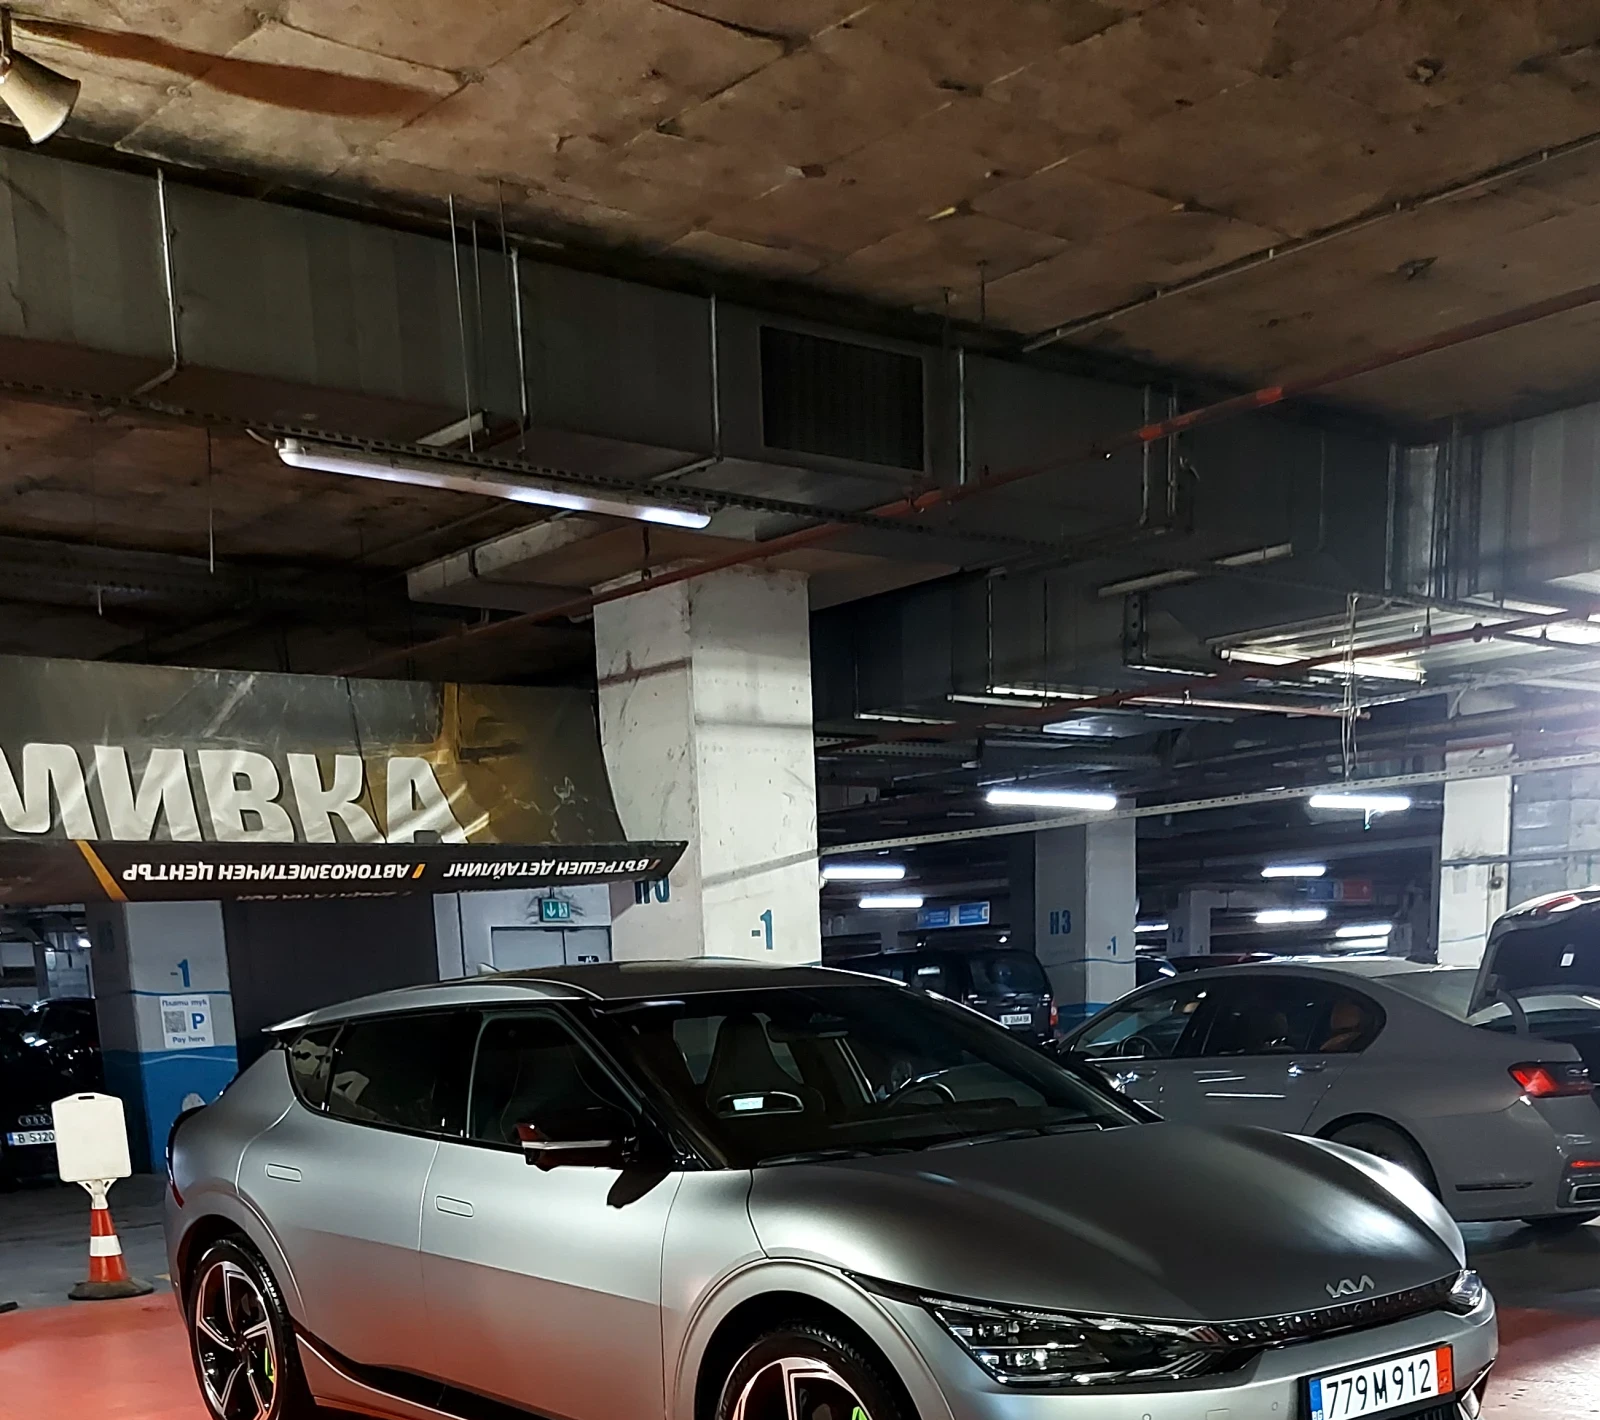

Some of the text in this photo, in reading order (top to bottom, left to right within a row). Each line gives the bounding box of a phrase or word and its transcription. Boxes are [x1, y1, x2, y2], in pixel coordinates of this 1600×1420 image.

[122, 861, 411, 881] АВТОКОЗМЕТИЧЕН ЦЕНТЪР
[443, 858, 650, 880] ВЪТРЕШЕН ДЕТАЙЛИНГ
[751, 909, 773, 950] -1
[1106, 935, 1117, 956] -1
[170, 958, 190, 988] -1
[191, 1012, 205, 1030] P
[172, 1036, 186, 1044] Pay
[1325, 1274, 1375, 1299] KIA
